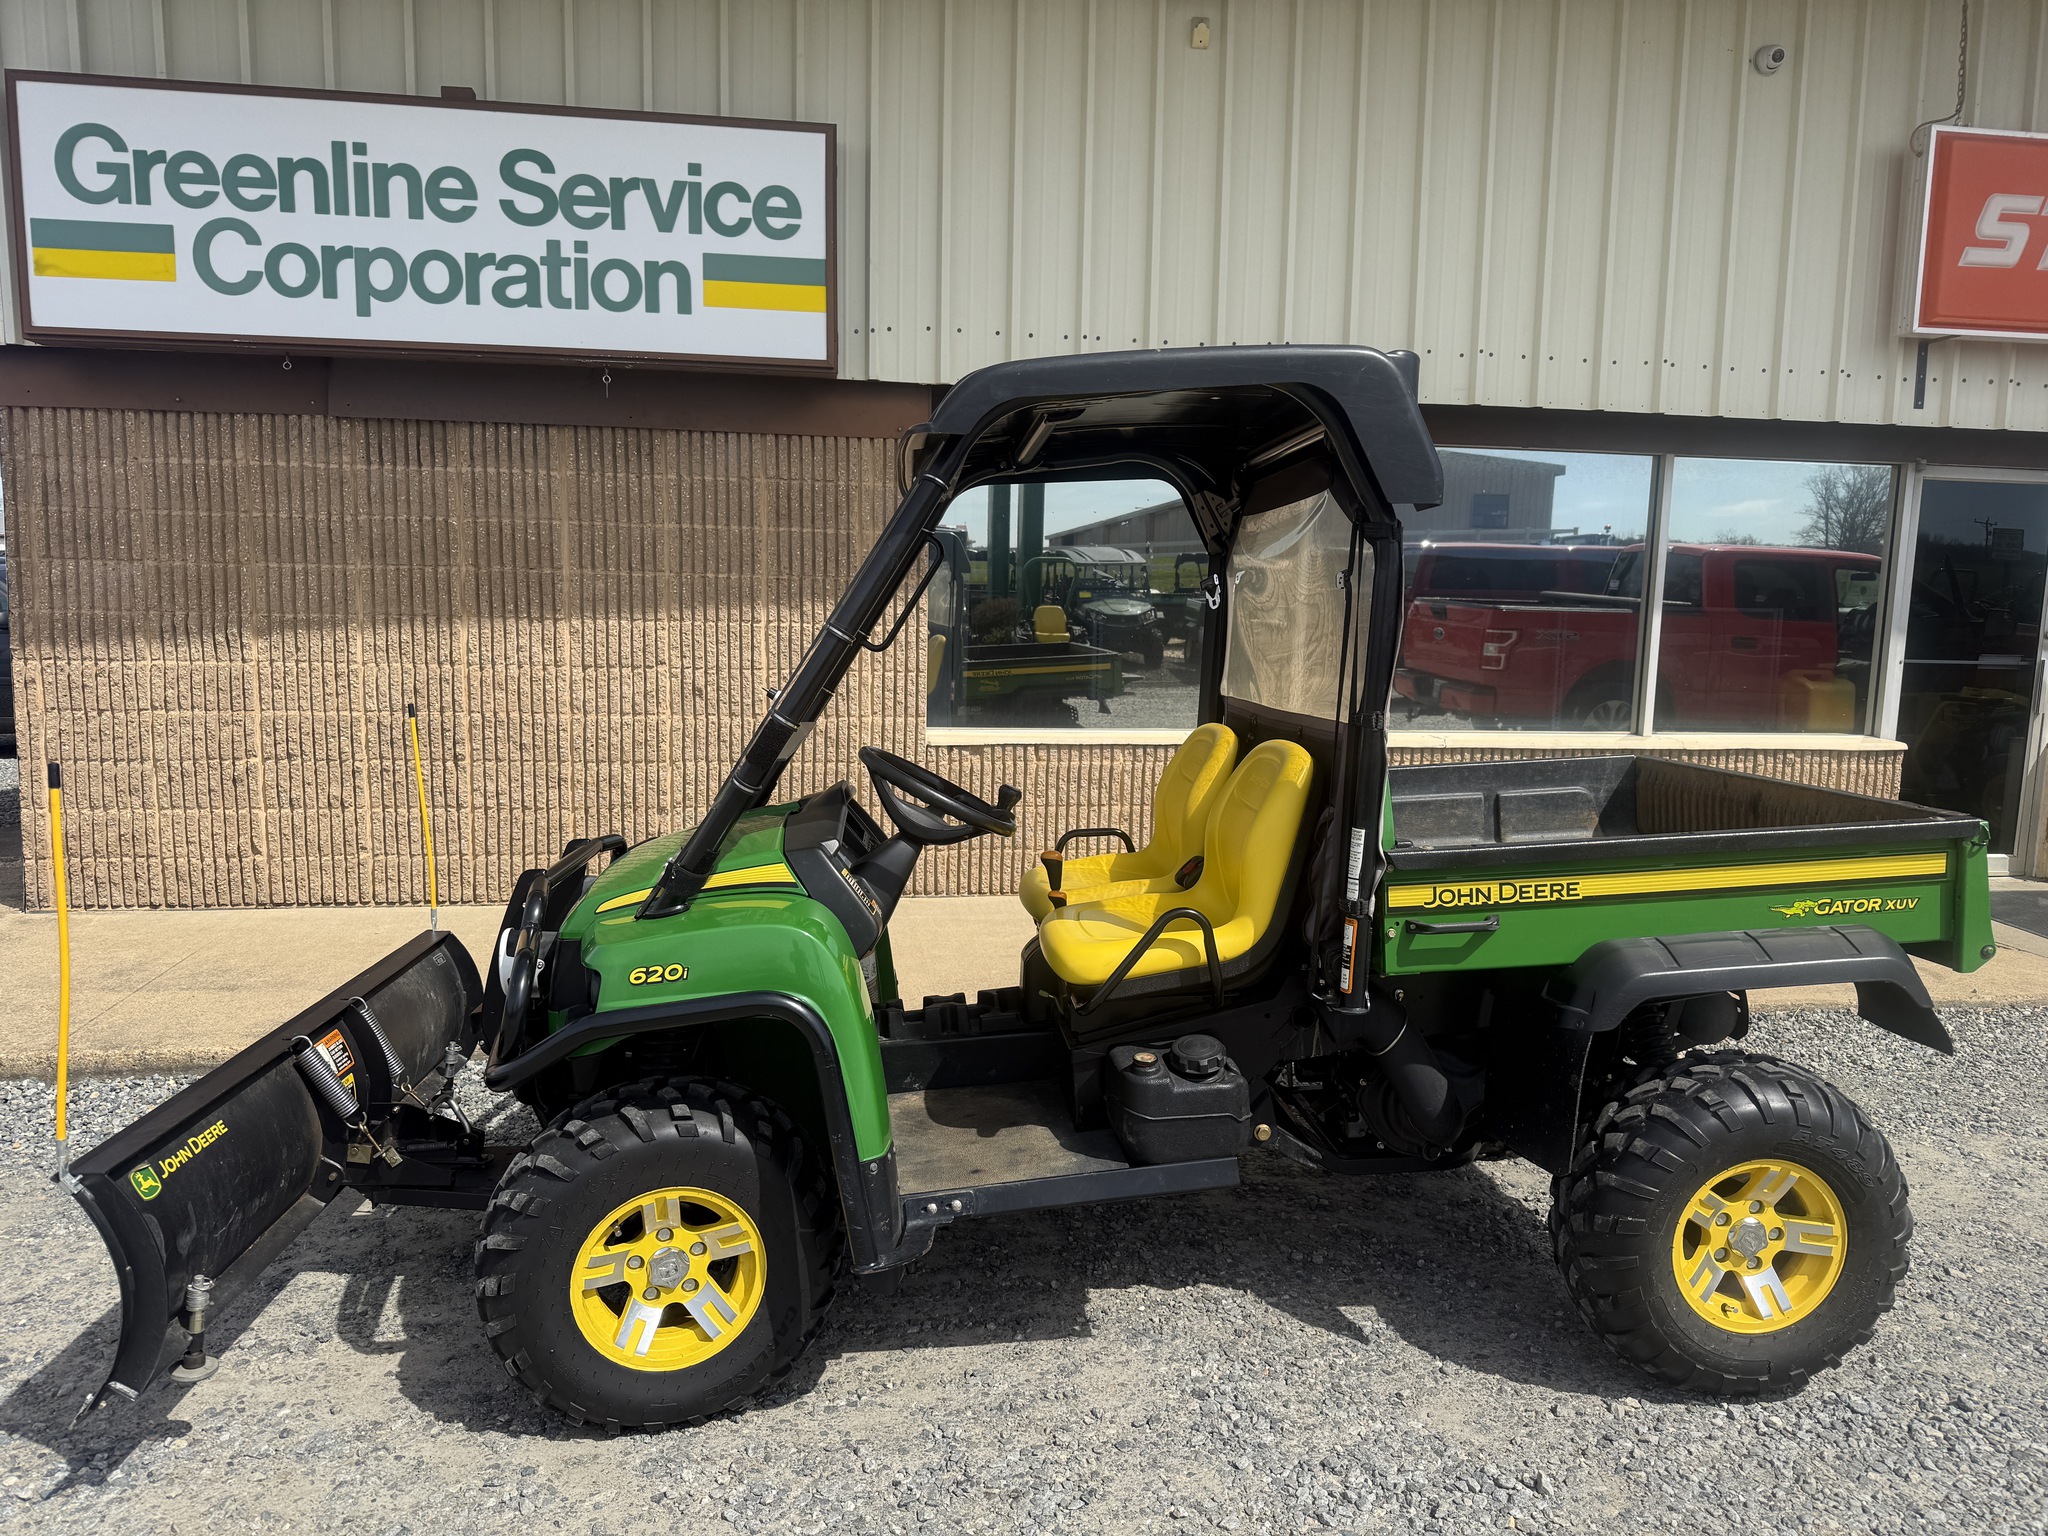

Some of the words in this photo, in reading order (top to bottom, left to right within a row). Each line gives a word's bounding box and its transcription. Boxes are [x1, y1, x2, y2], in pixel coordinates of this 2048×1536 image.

[54, 123, 479, 224] Greenline
[499, 149, 803, 242] Service
[1957, 193, 2048, 270] S
[193, 217, 693, 317] Corporation
[1424, 886, 1492, 906] JOHN
[1499, 882, 1581, 902] DEERE
[1814, 898, 1882, 915] GATOR
[1885, 898, 1918, 910] XUV
[629, 963, 688, 985] 620i
[158, 1146, 194, 1179] JOHN
[187, 1119, 229, 1154] DEERE
